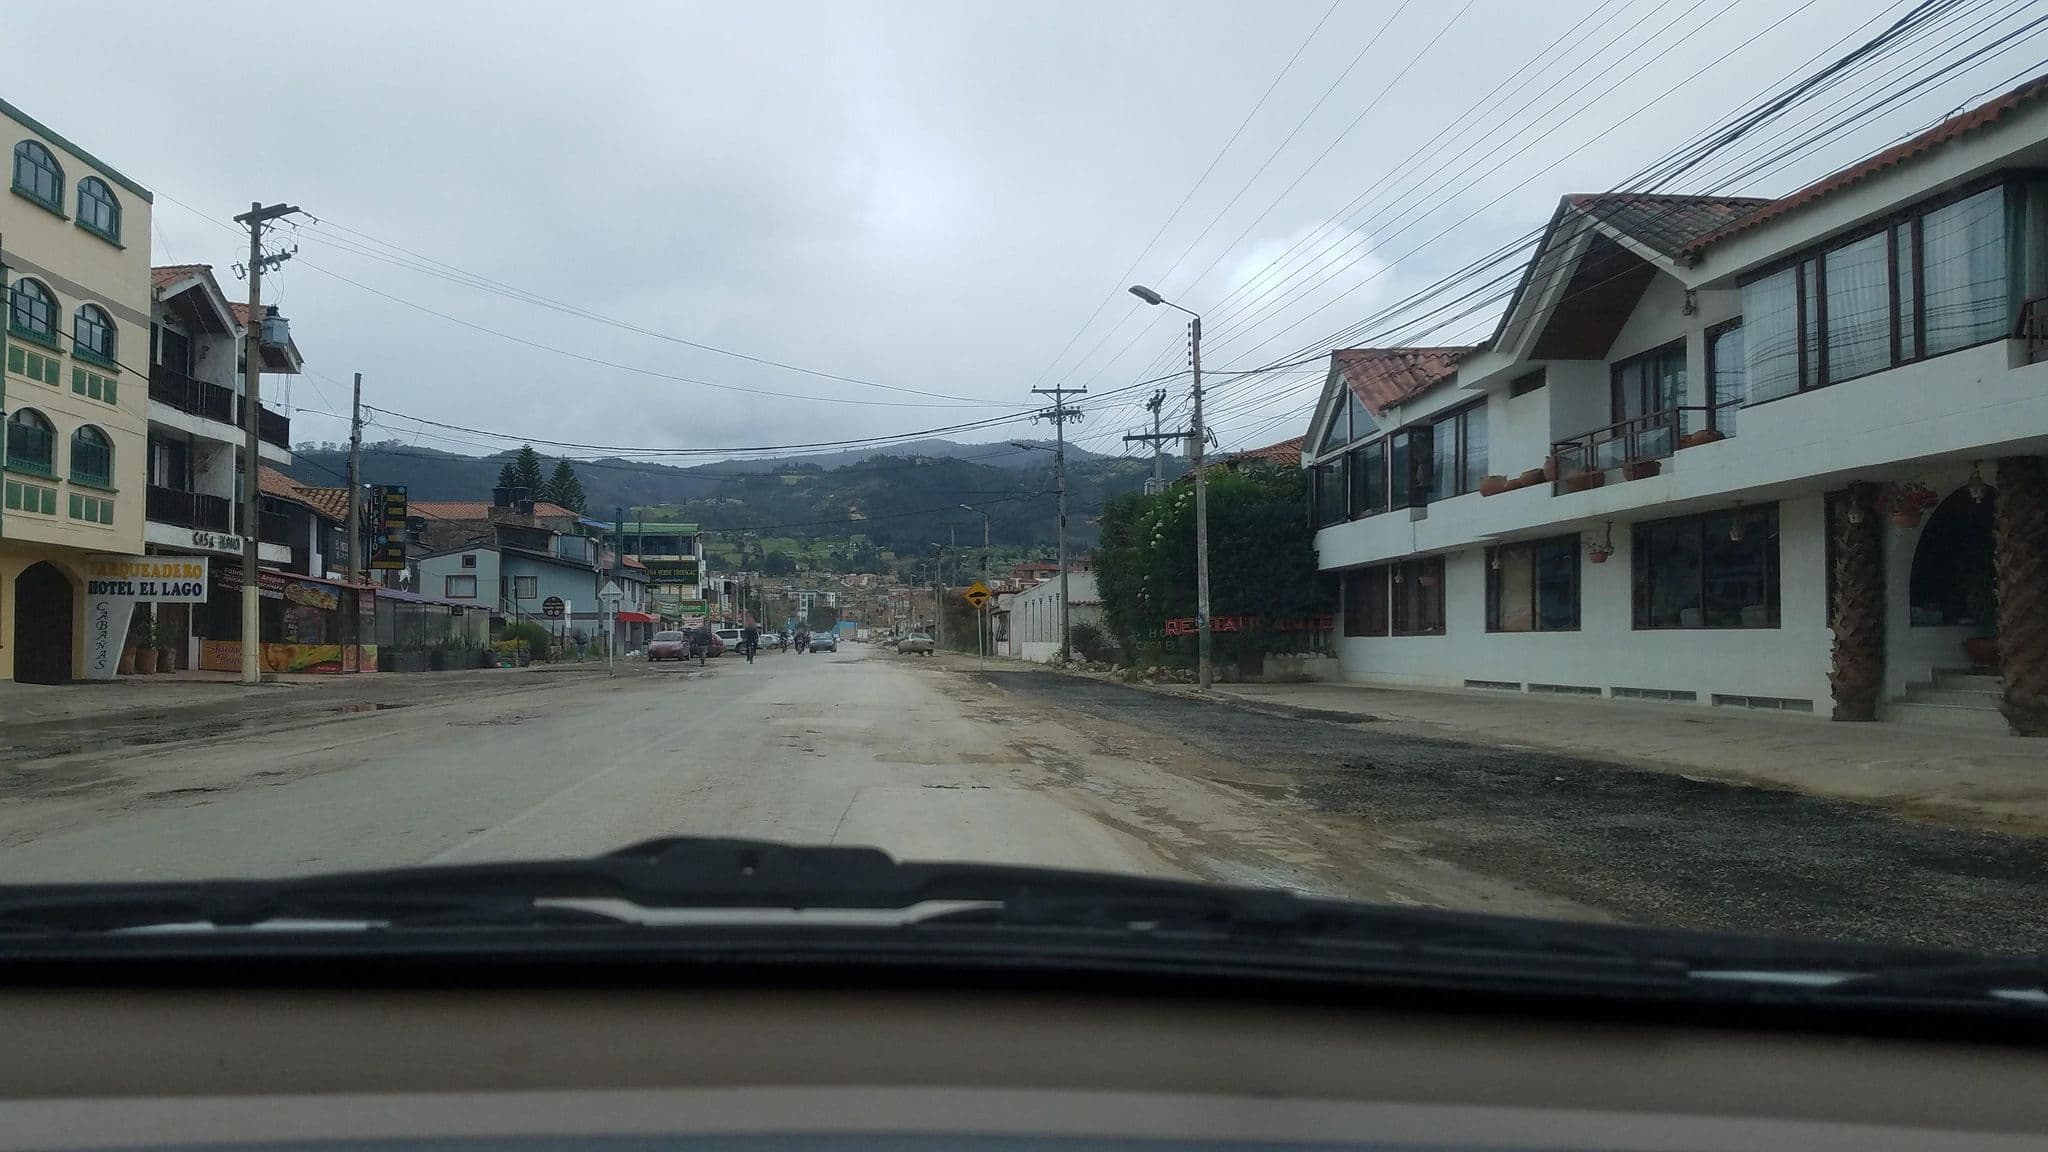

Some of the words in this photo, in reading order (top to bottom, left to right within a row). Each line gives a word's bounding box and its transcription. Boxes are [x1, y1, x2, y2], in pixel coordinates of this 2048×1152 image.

[88, 580, 135, 596] HOTEL
[140, 582, 158, 596] EL
[162, 582, 203, 597] LAGO
